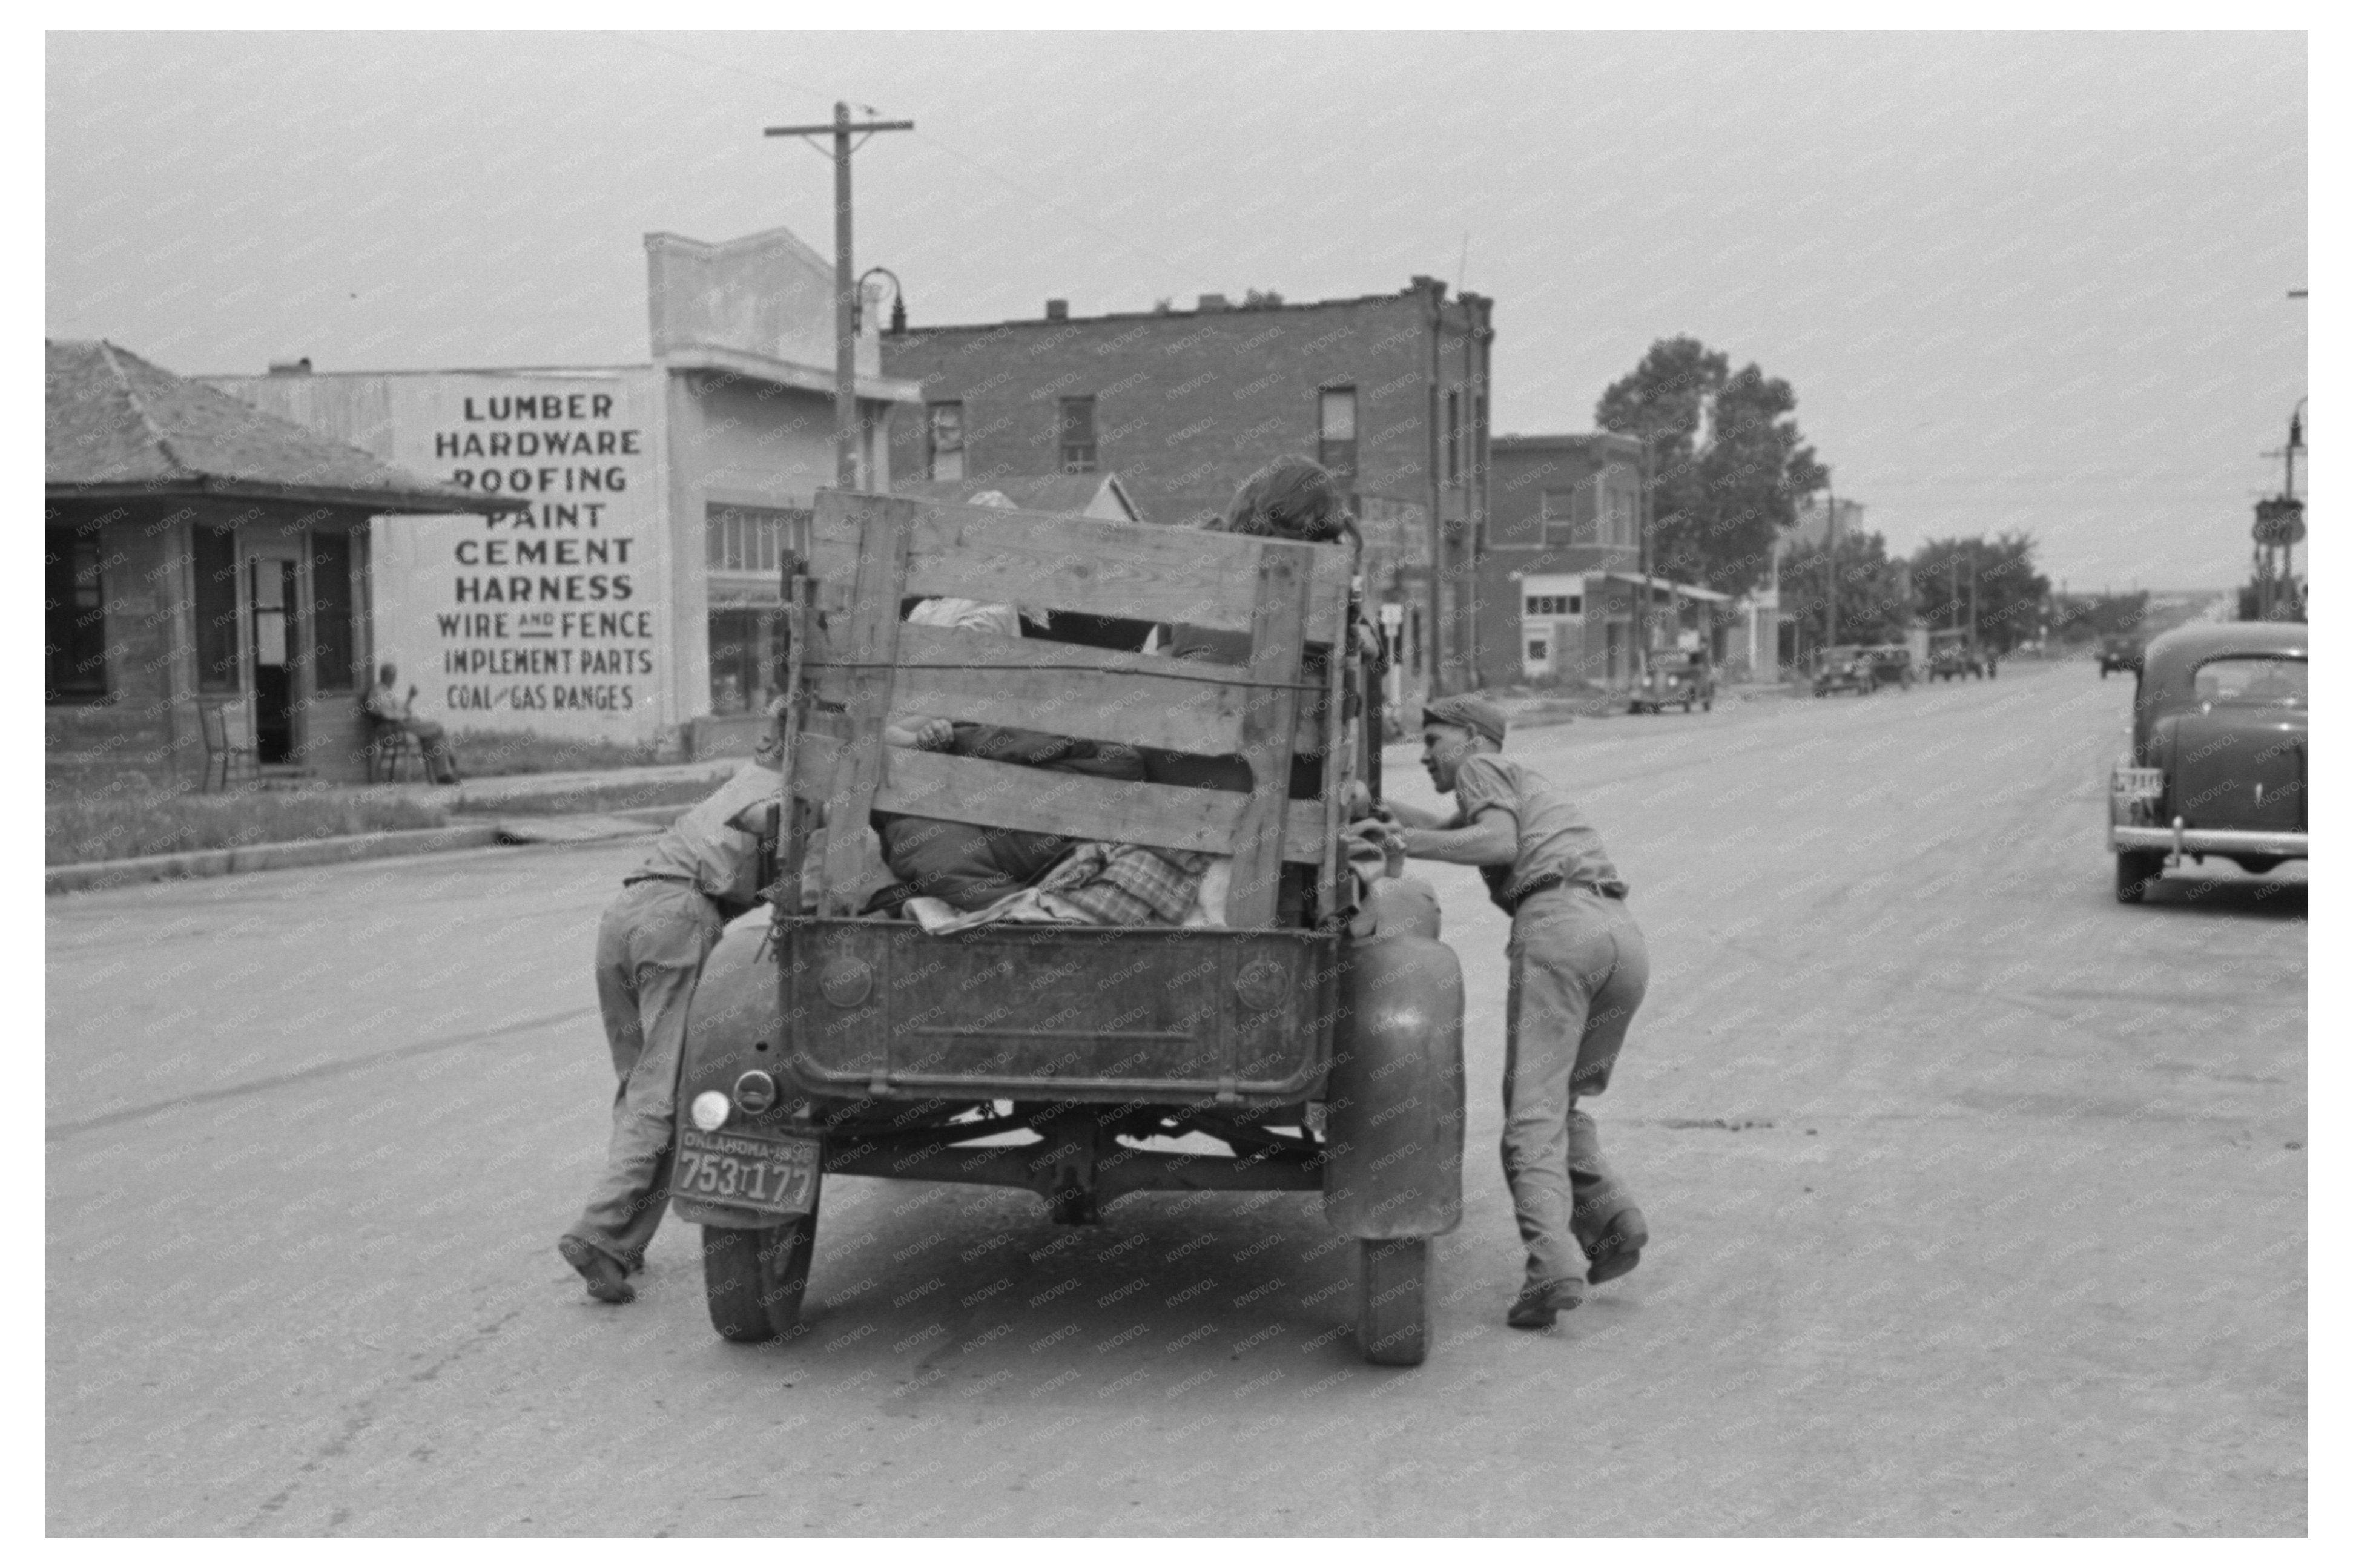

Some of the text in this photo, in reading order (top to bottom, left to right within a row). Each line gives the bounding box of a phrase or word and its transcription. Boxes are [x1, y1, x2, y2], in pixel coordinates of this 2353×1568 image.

[463, 394, 613, 421] LUMBER
[435, 430, 641, 458] HARDWARE
[454, 466, 626, 492] ROOFING
[454, 538, 634, 566] CEMENT
[455, 575, 633, 603] HARNESS
[437, 611, 653, 639] WIRE AND FENCE
[444, 648, 653, 675] IMPLEMENT PARTS
[552, 684, 634, 711] RANGES
